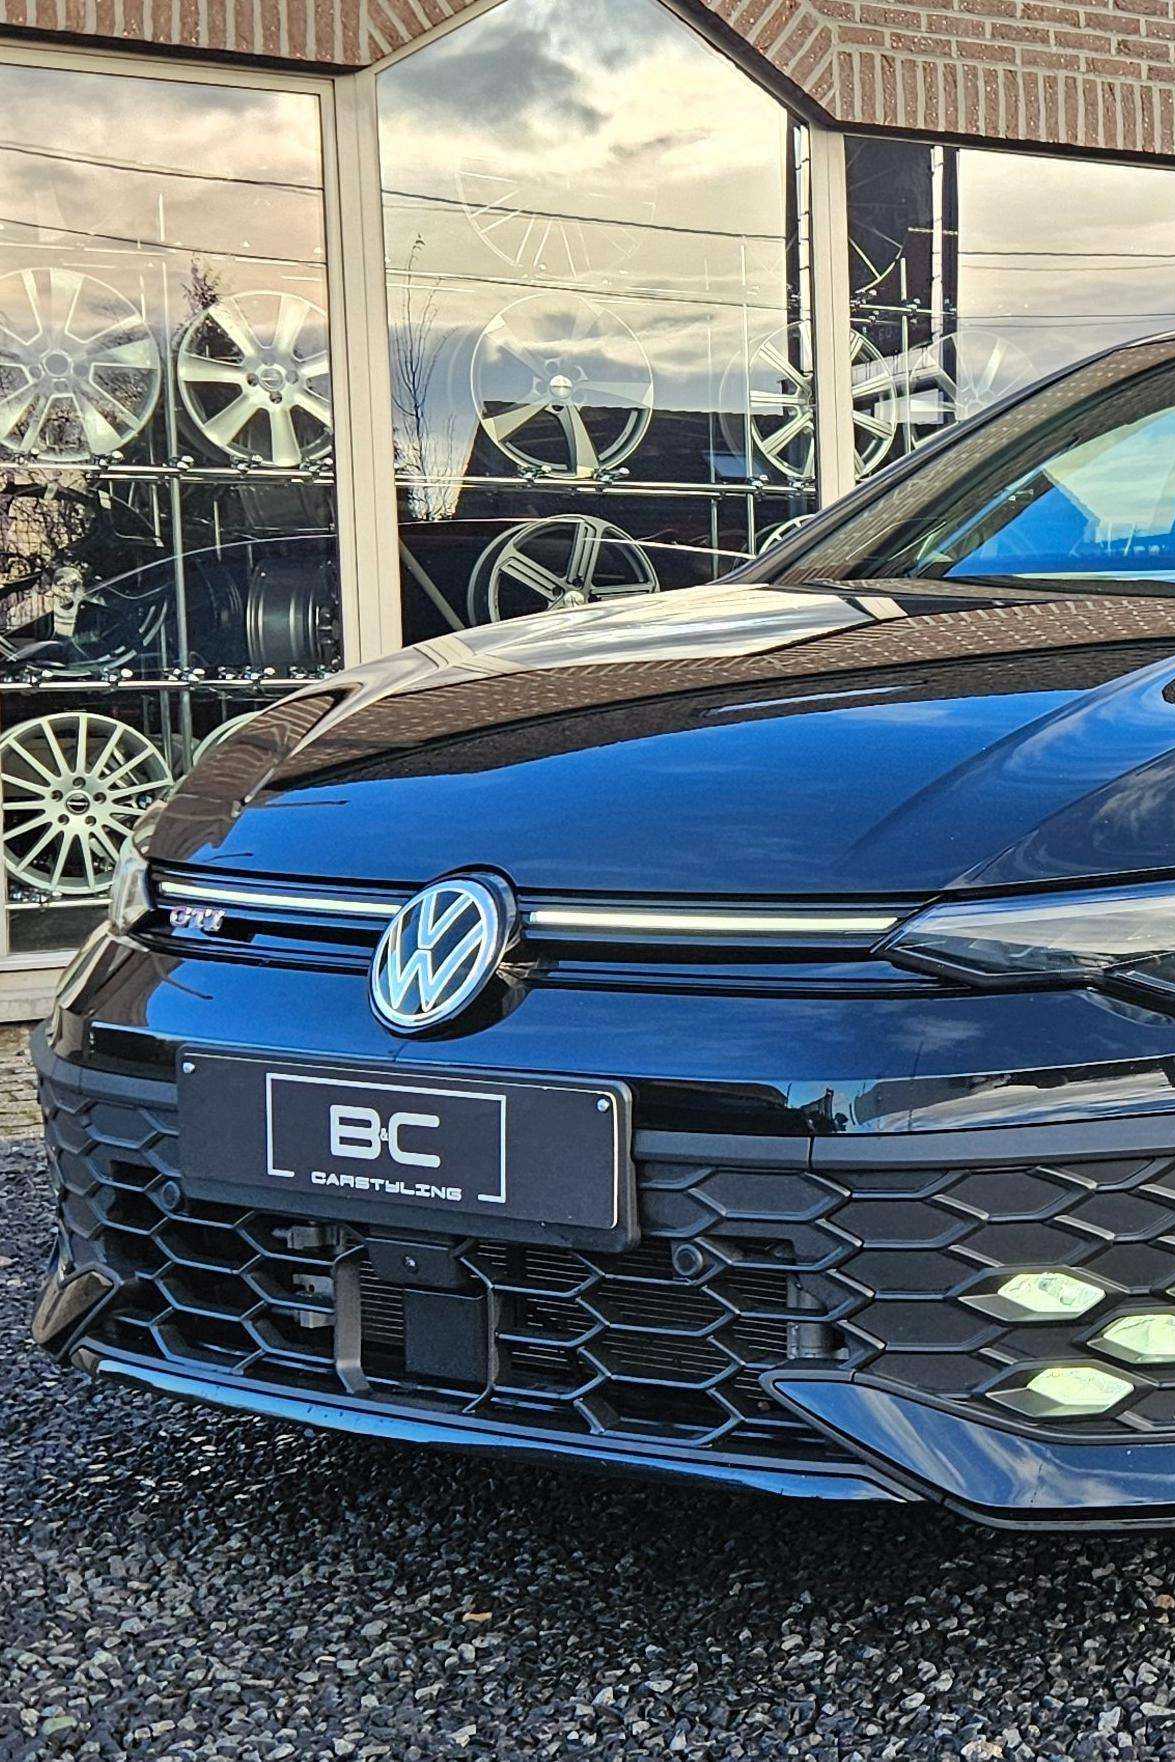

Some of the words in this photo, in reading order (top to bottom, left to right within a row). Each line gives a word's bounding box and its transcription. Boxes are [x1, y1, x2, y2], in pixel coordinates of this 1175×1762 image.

[169, 905, 226, 932] GTI
[329, 1104, 441, 1168] B&C
[310, 1170, 463, 1202] CARSTYLING
